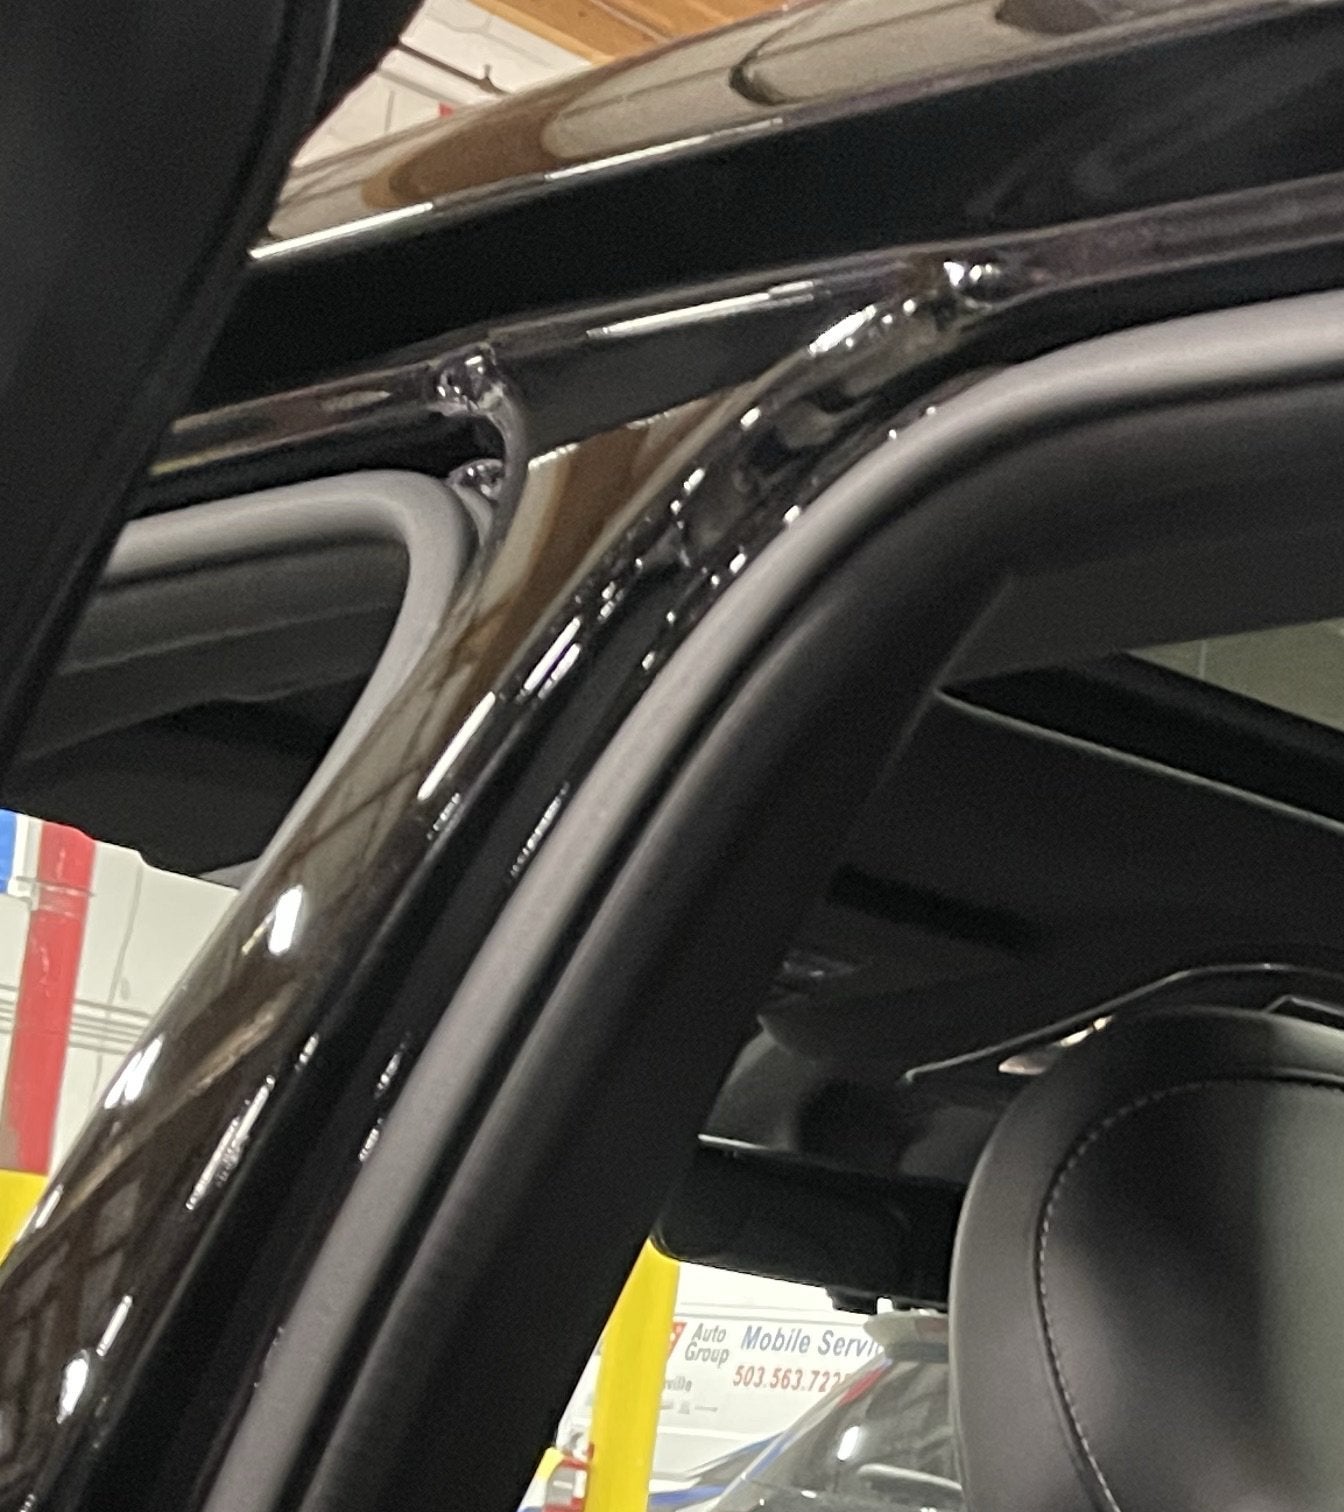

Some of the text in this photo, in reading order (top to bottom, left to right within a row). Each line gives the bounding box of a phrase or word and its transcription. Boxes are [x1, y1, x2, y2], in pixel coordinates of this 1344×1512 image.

[691, 1323, 727, 1343] Auto
[740, 1325, 811, 1354] Mobile
[684, 1341, 730, 1367] Group
